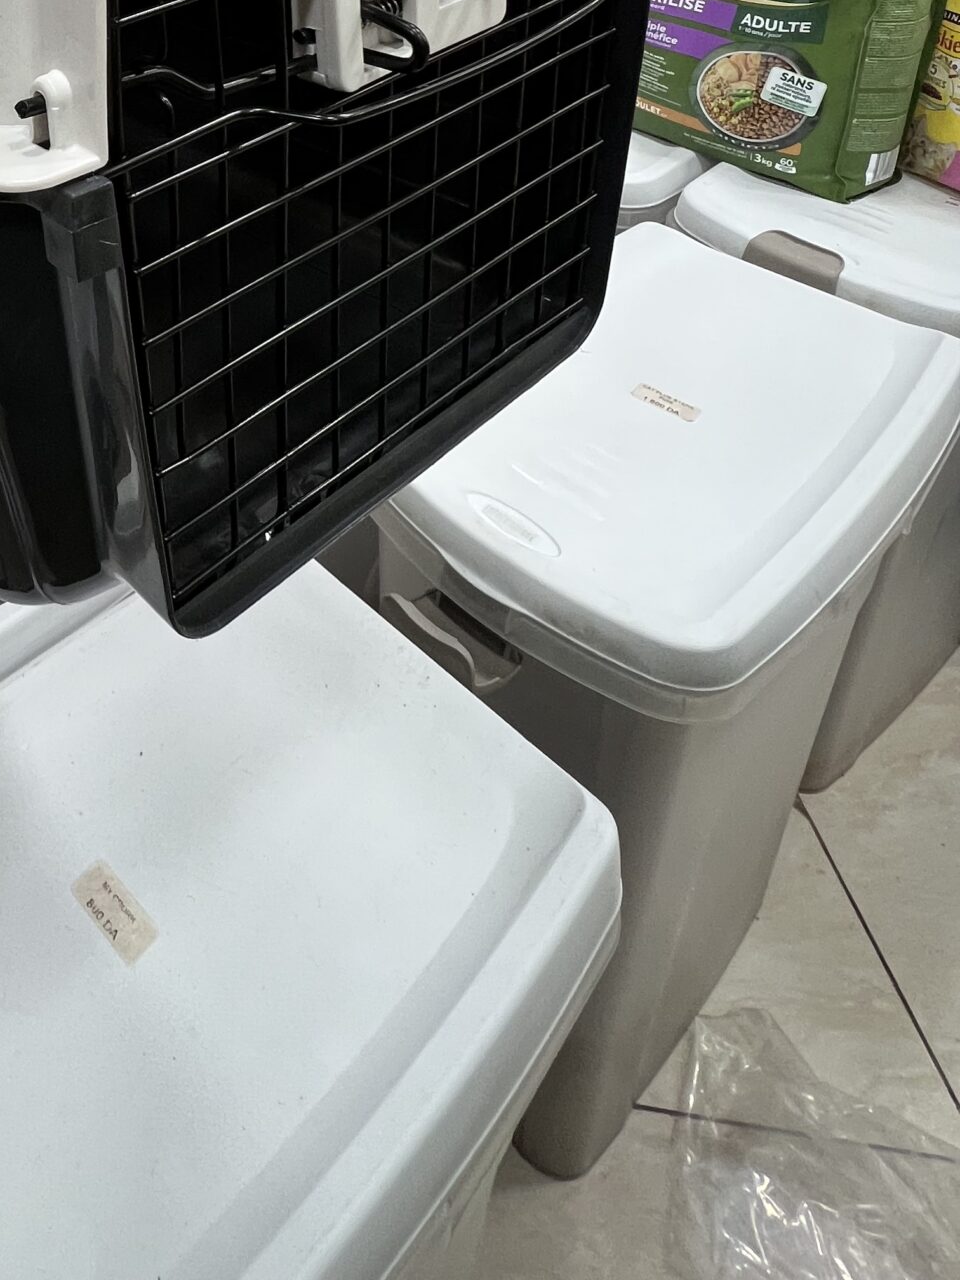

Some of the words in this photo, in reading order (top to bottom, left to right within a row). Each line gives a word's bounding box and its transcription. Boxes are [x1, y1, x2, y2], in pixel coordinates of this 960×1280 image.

[740, 13, 812, 33] ADULTE
[930, 63, 938, 76] 5
[780, 72, 815, 91] SANS
[780, 158, 794, 167] 60
[103, 919, 118, 941] DA
